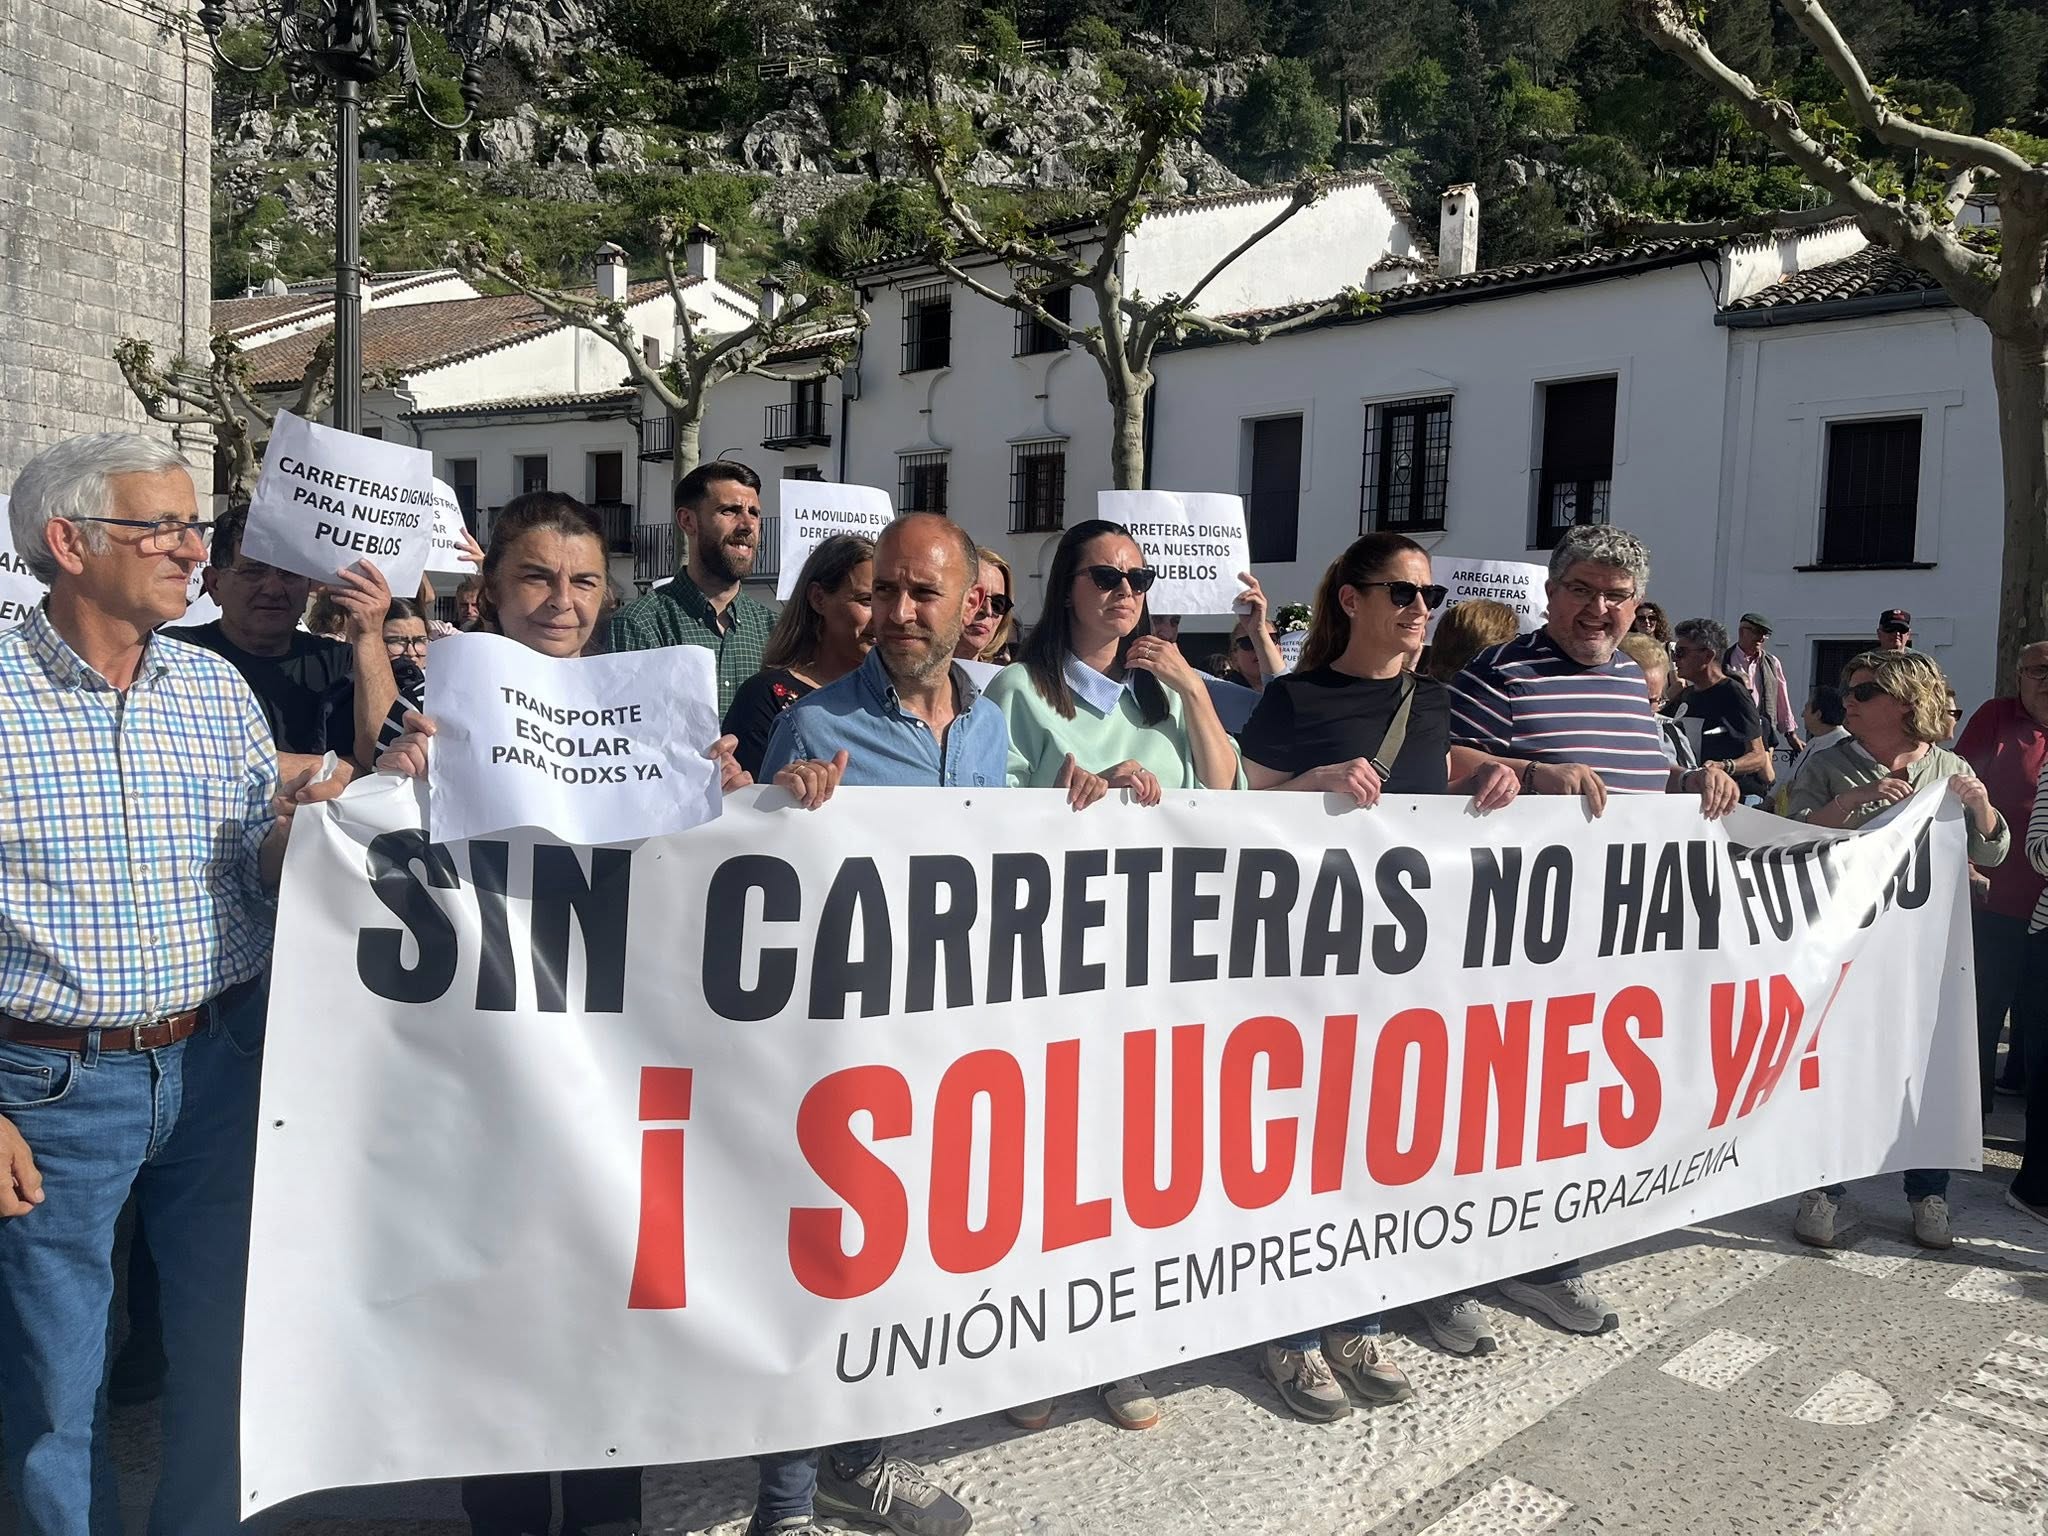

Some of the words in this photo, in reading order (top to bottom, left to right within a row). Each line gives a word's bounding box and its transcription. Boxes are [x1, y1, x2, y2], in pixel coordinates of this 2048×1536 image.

[279, 456, 398, 502] CARRETERAS
[293, 486, 345, 516] PARA
[351, 504, 420, 529] NUESTROS
[794, 508, 809, 520] LA
[811, 509, 867, 524] MOVILIDAD
[869, 513, 880, 525] ES
[314, 521, 402, 556] PUEBLOS
[1121, 523, 1195, 537] ARRETERAS
[1199, 525, 1242, 539] DIGNAS
[1163, 544, 1231, 557] NUESTROS
[1451, 571, 1510, 584] ARREGLAR
[1512, 574, 1530, 586] LAS
[1456, 585, 1527, 600] CARRETERAS
[1515, 604, 1531, 614] EN
[500, 686, 643, 727] TRANSPORTE
[515, 717, 632, 758] ESCOLAR
[491, 745, 548, 774] PARA
[549, 761, 628, 785] TODXS
[632, 763, 664, 781] YA
[356, 828, 632, 1013] SIN
[701, 846, 1432, 1021] CARRETERAS
[1462, 844, 1574, 969] NO
[1597, 840, 1722, 957] HAY
[788, 985, 1664, 1300] SOLUCIONES
[835, 1287, 1046, 1384] UNIÓN
[1068, 1266, 1137, 1334] DE
[1155, 1200, 1475, 1311] EMPRESARIOS
[1487, 1189, 1544, 1237] DE
[1553, 1137, 1740, 1223] GRAZALEMA
